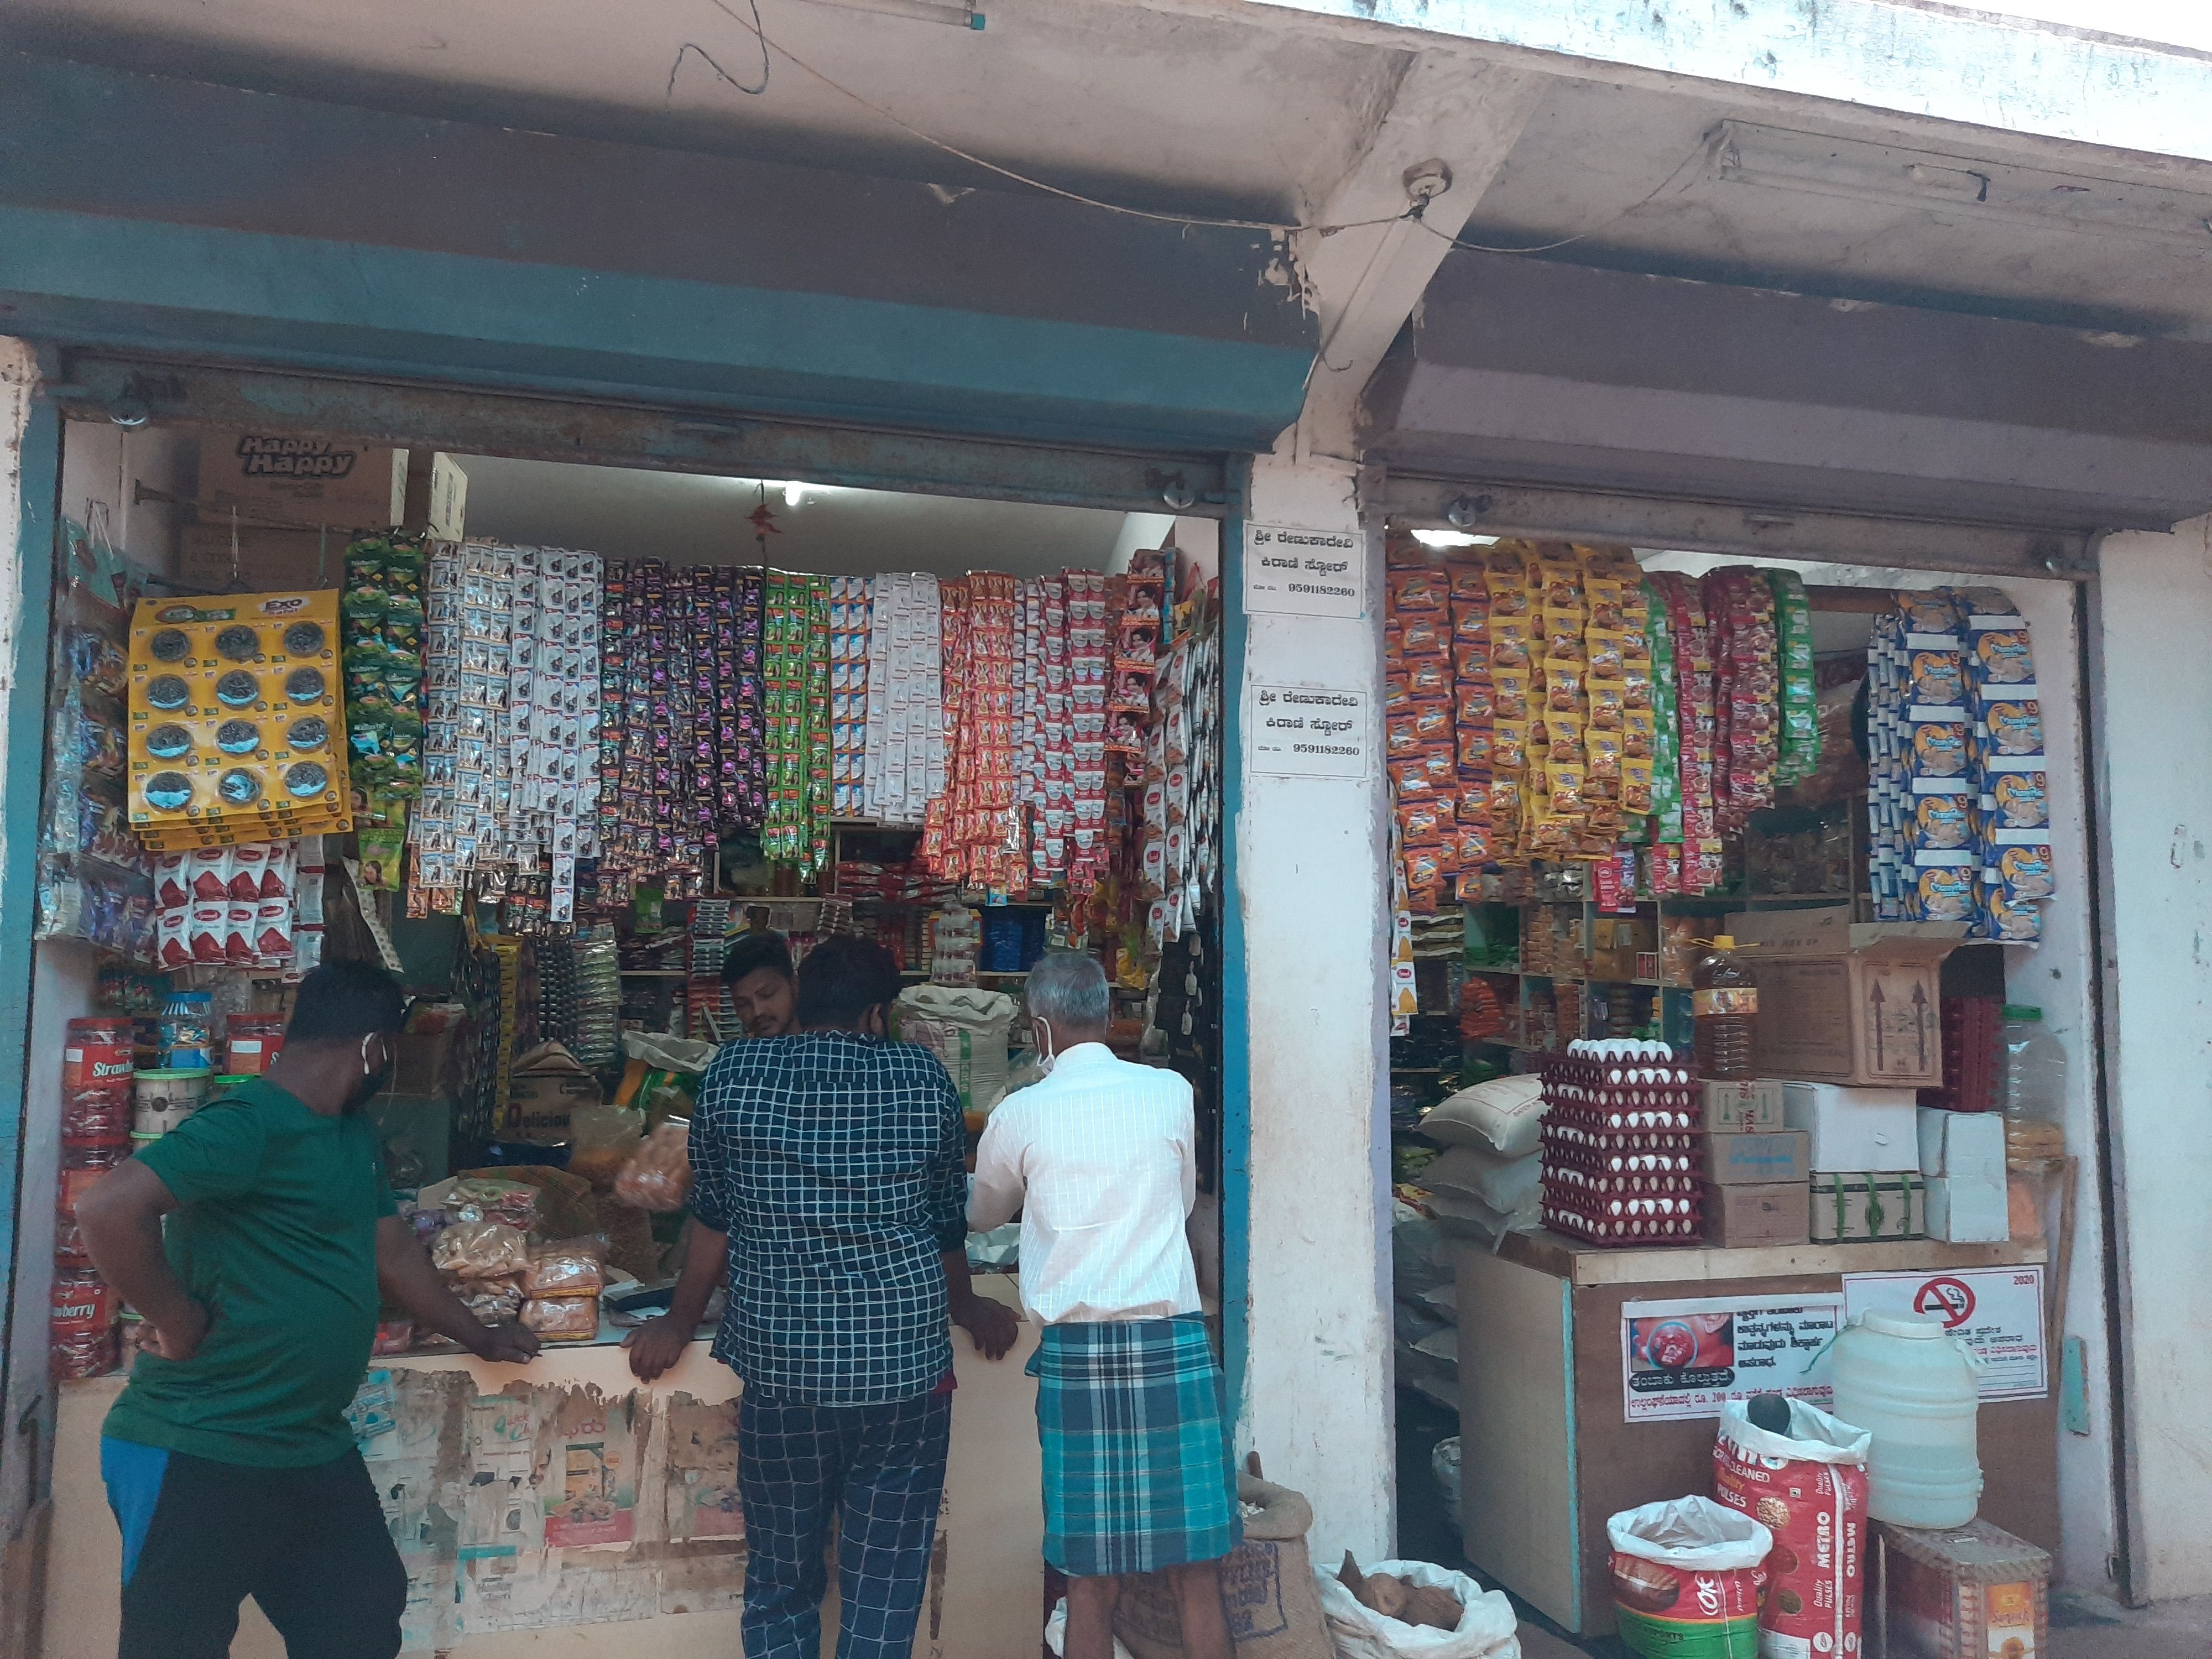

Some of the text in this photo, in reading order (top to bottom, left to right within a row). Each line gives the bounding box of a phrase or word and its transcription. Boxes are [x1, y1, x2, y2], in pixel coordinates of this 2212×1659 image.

[241, 436, 331, 456] Happy
[247, 452, 354, 476] Happy
[1254, 529, 1354, 549] ಶ್ರೀ ರೇಣುಕಾದೇವಿ
[1305, 557, 1348, 577] ಸ್ಟೋರ್
[1288, 582, 1355, 597] 9591182260
[1259, 689, 1358, 707] ಶ್ರೀ ರೇಣುಕಾದೇವಿ
[1309, 717, 1353, 737] ಸ್ಟೋರ್
[1293, 743, 1360, 757] 9591182260
[1632, 1374, 1675, 1387] ತಂಬಾಕು
[1716, 1482, 1747, 1509] PULSES
[1816, 1511, 1831, 1569] METRO
[1846, 1522, 1857, 1578] METRO
[1813, 1578, 1825, 1608] Quality
